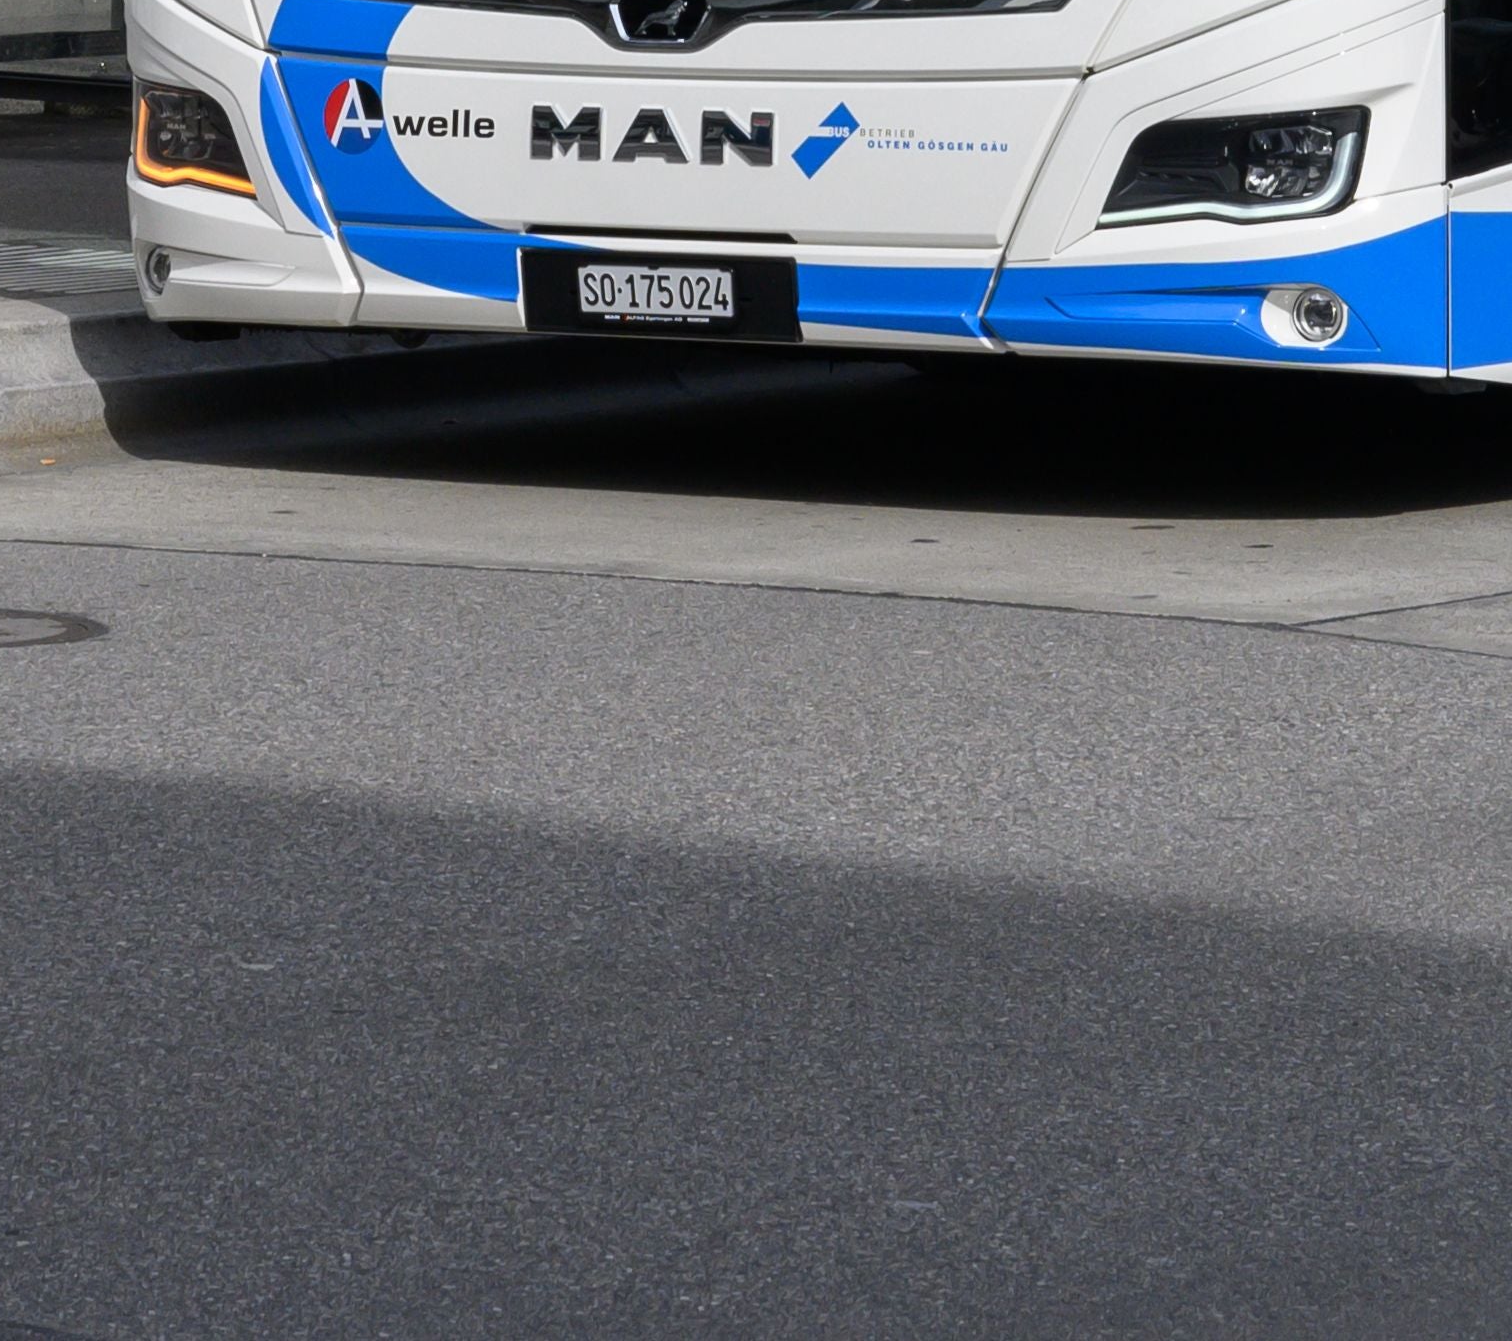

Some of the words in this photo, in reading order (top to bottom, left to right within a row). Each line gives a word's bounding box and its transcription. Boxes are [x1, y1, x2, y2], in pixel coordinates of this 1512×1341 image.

[392, 109, 496, 139] welle
[530, 103, 774, 167] MAN
[859, 127, 916, 139] BETRIEB
[867, 139, 911, 150] OLTEN
[917, 140, 975, 152] GÖSGEN
[980, 141, 1009, 153] GÄU
[679, 275, 730, 313] 024
